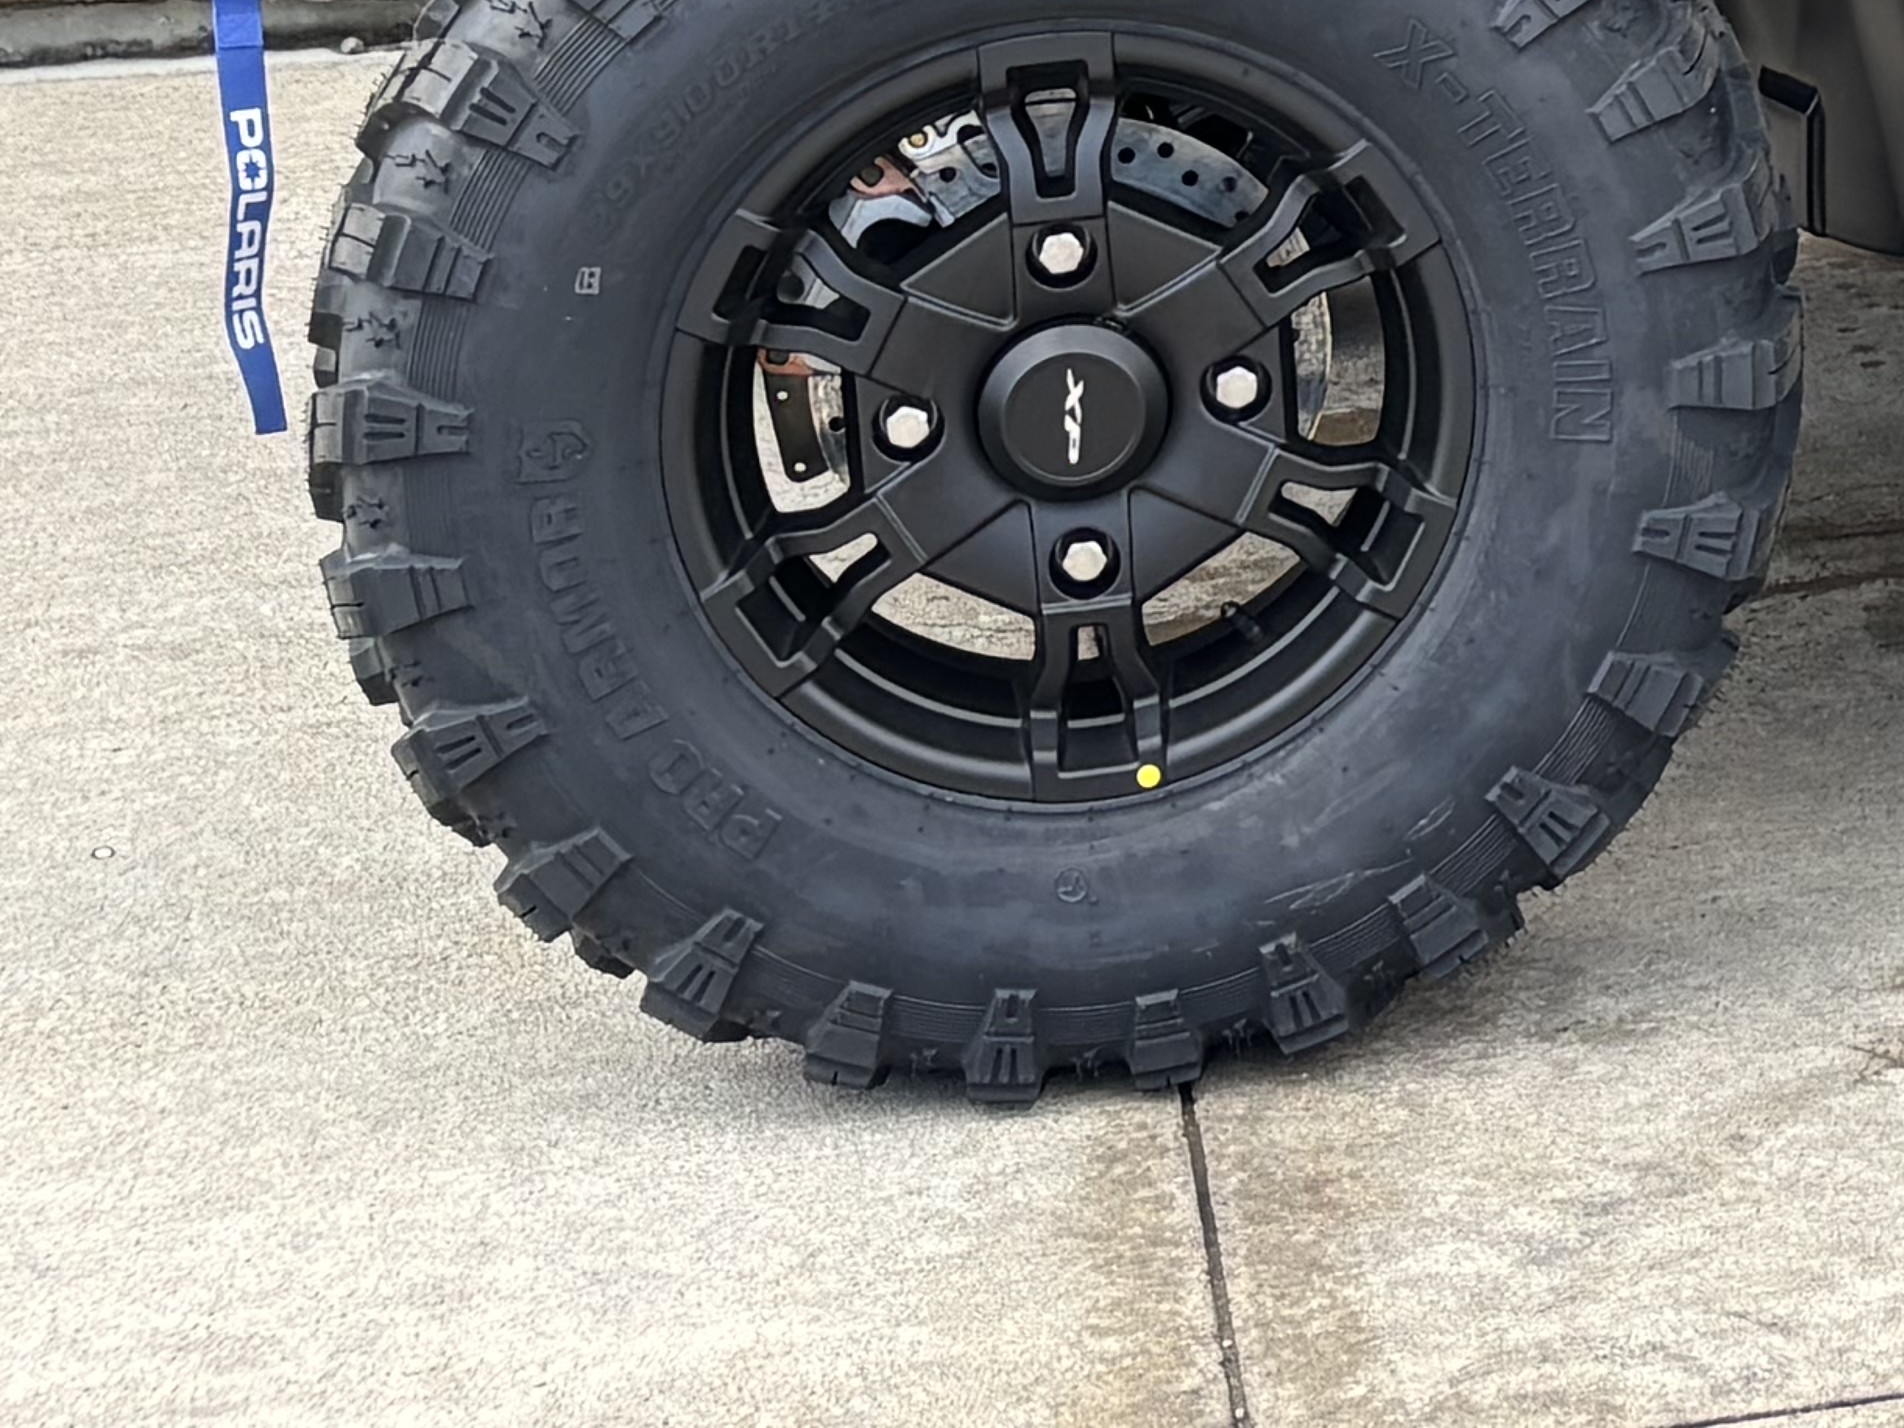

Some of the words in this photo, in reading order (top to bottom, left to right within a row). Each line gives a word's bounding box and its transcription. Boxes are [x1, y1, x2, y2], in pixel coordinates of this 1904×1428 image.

[226, 106, 270, 352] POLARIS
[1373, 18, 1614, 444] X-TERRAIN
[530, 495, 670, 741] ARMOR
[646, 737, 784, 861] PRO
